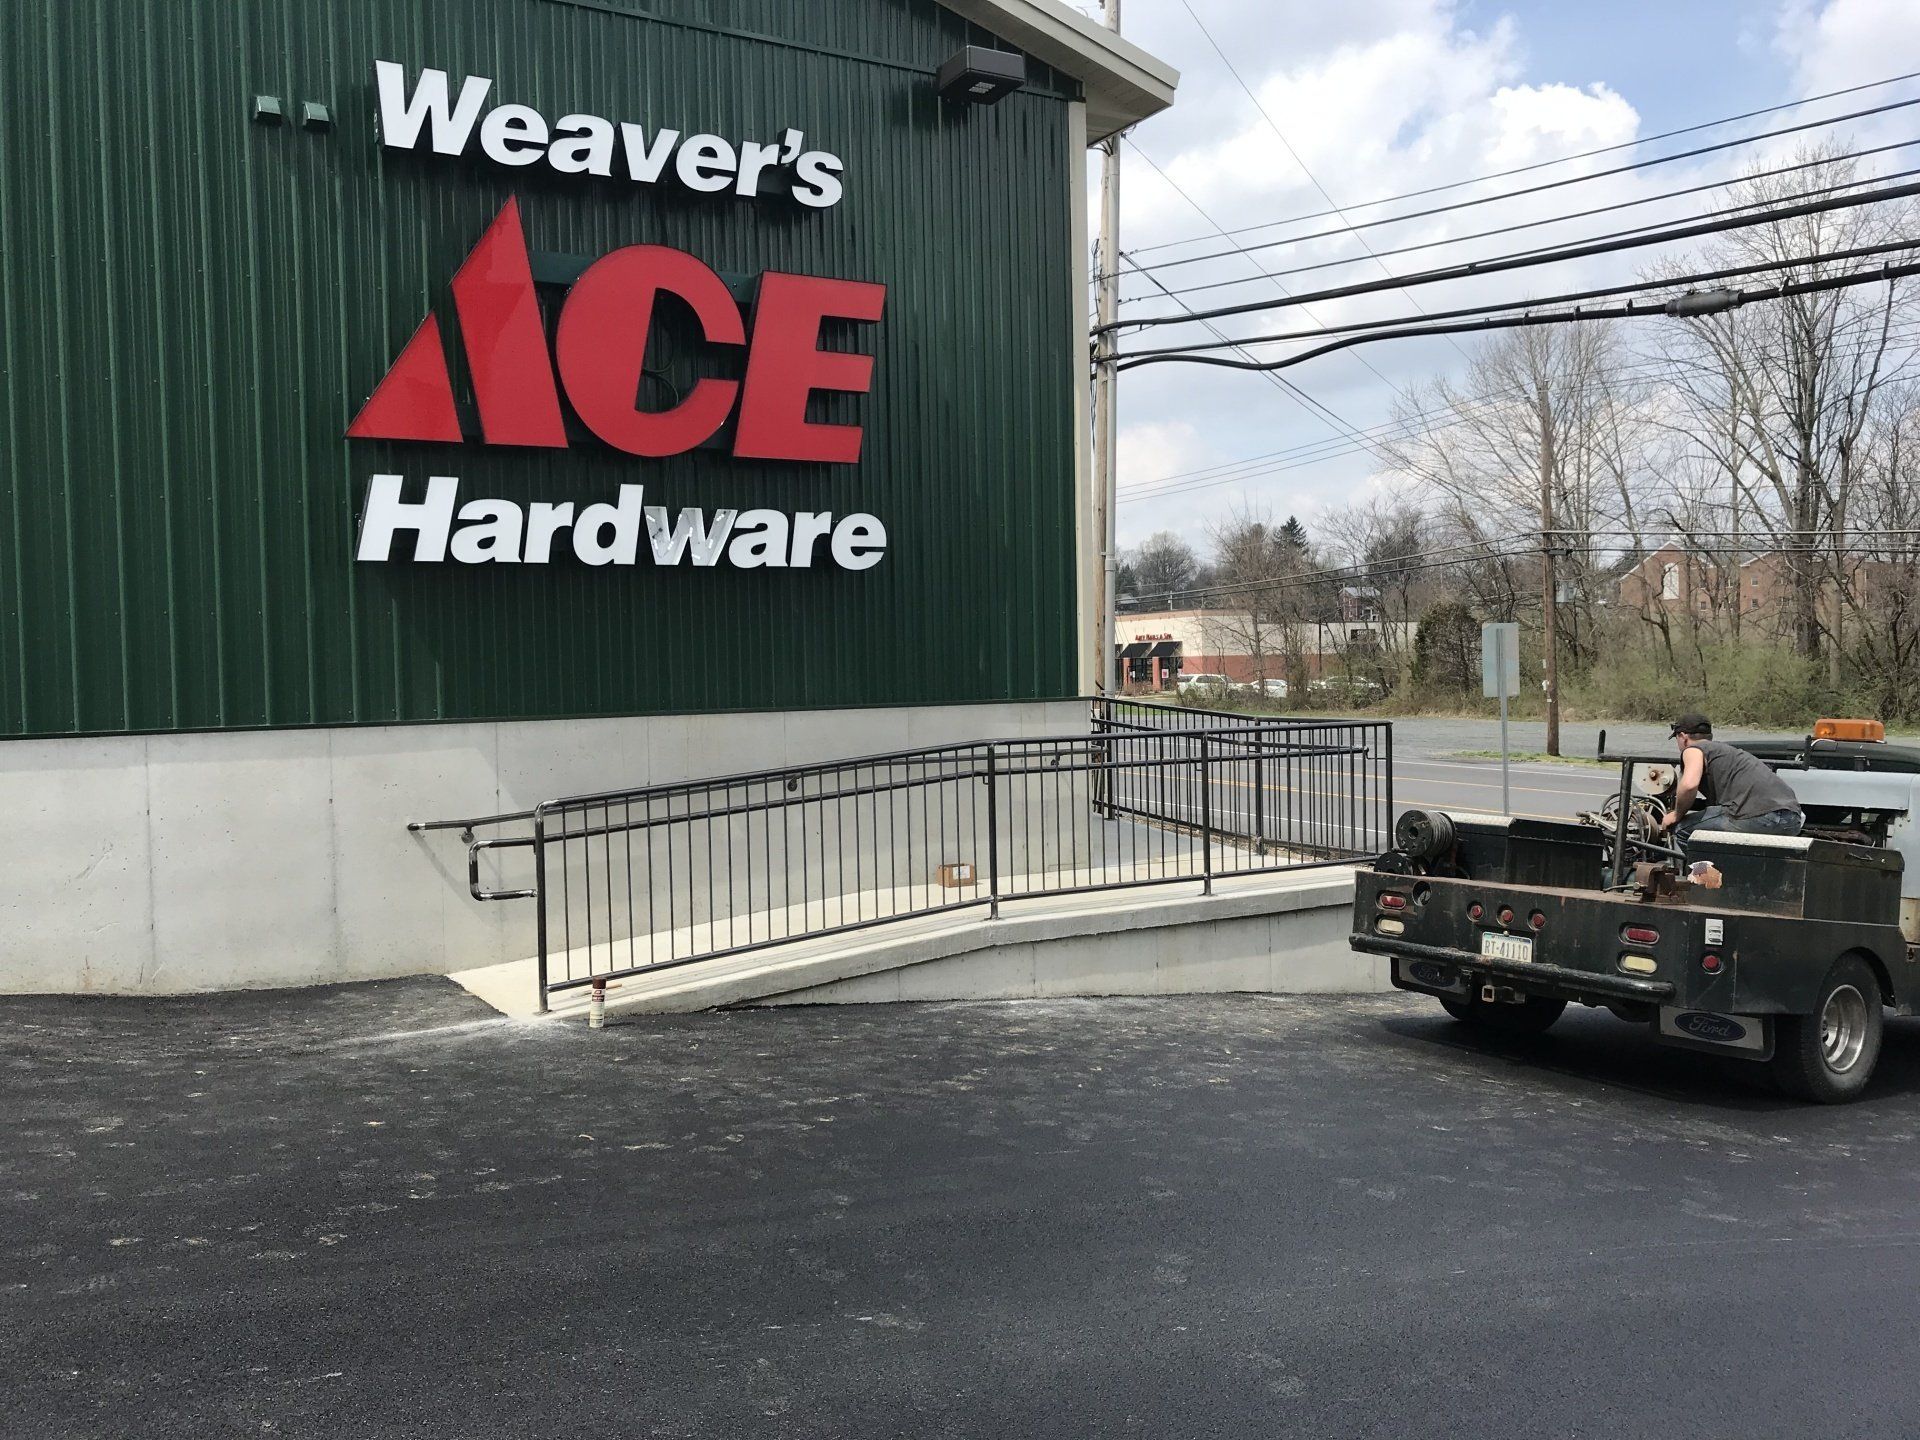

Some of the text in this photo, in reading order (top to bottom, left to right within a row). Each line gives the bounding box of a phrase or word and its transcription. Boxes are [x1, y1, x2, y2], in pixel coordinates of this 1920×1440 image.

[375, 59, 844, 208] Weaver's
[345, 194, 887, 464] ACE
[357, 474, 887, 570] Hardware
[1689, 1015, 1730, 1037] Ford
